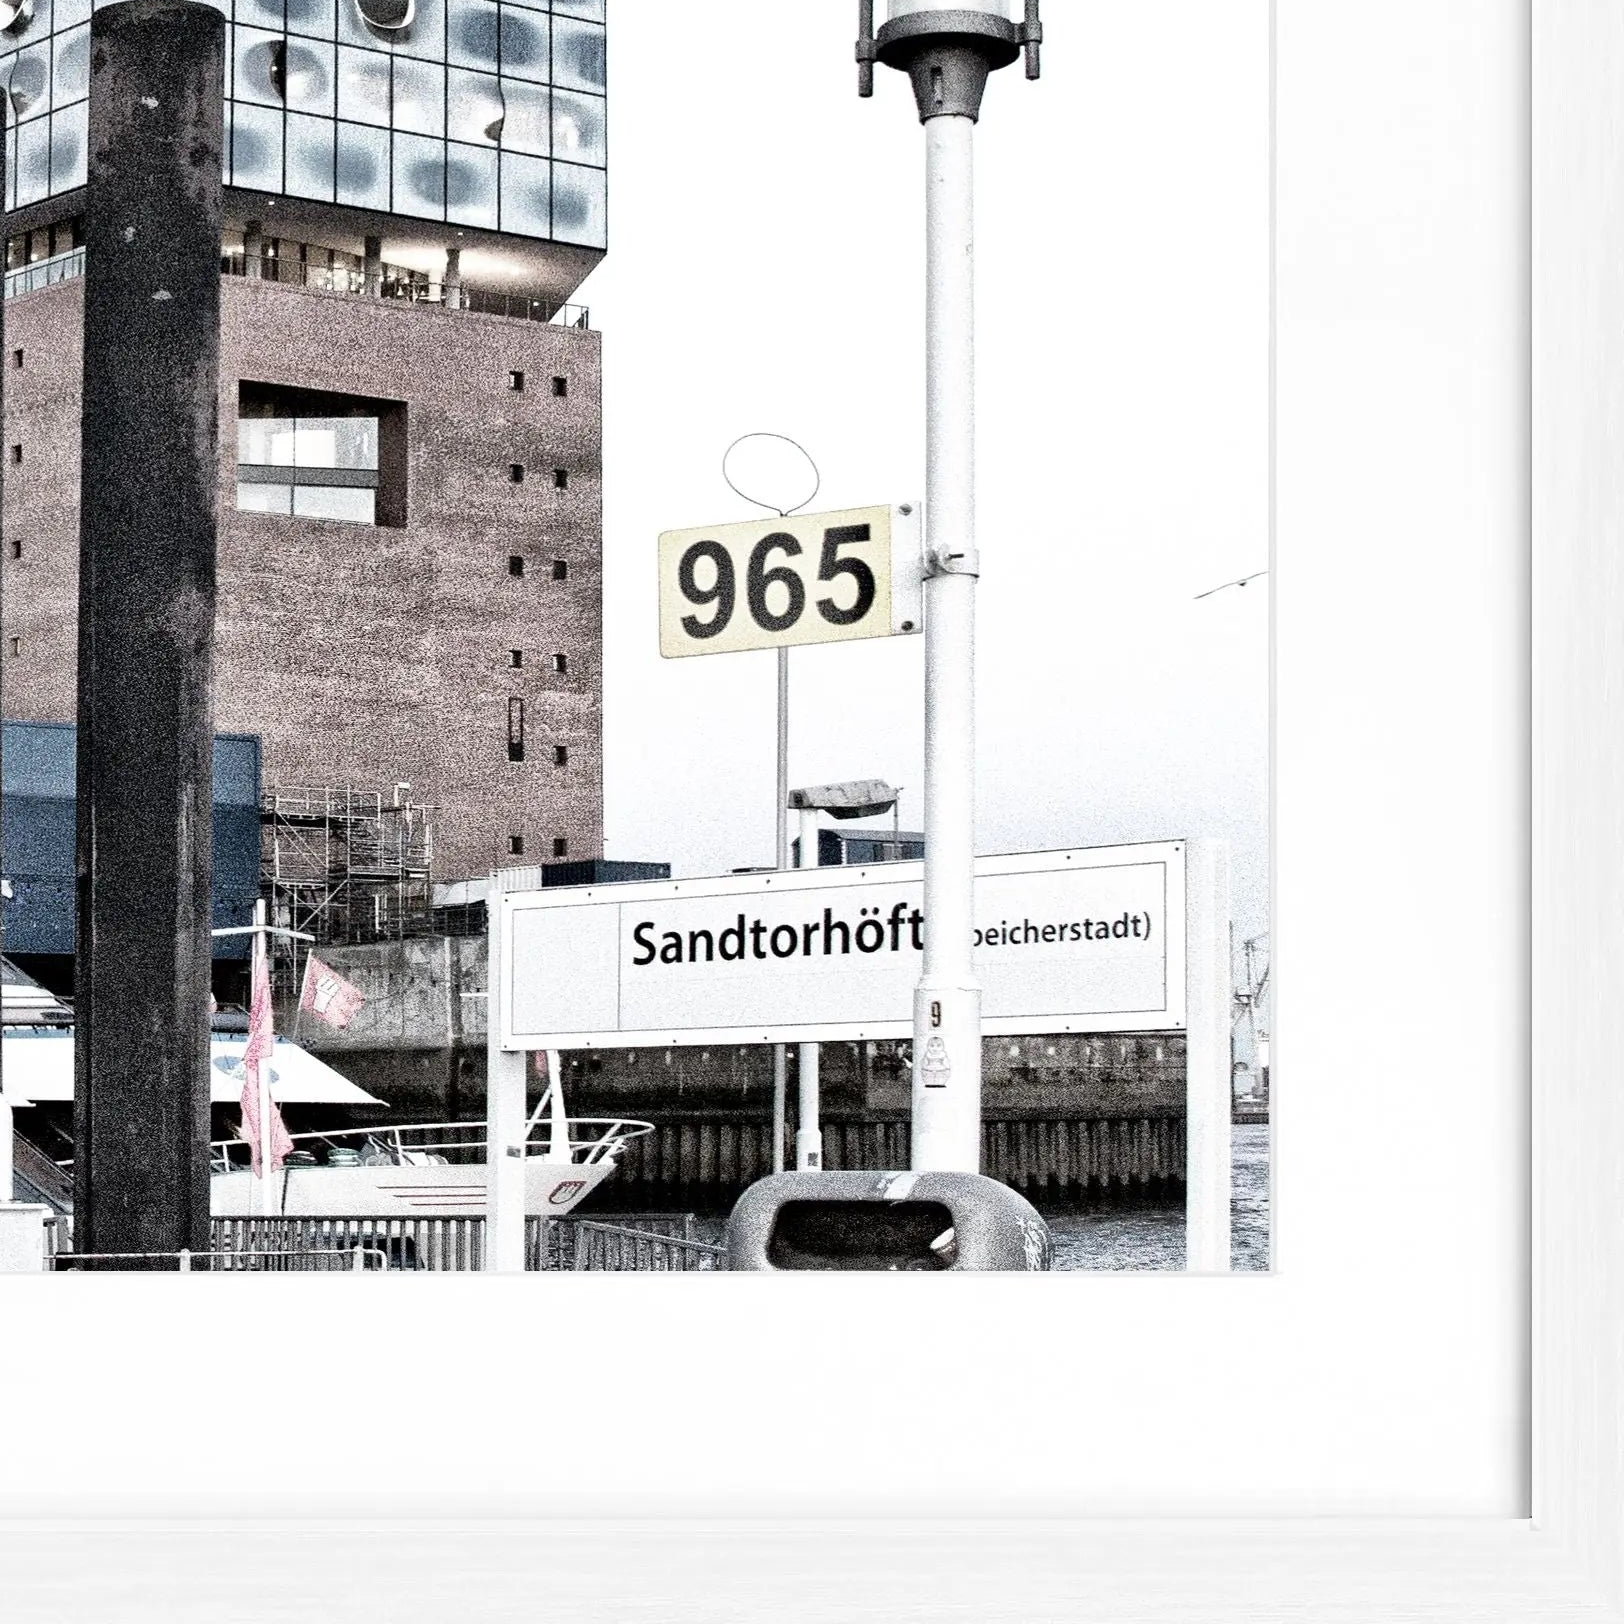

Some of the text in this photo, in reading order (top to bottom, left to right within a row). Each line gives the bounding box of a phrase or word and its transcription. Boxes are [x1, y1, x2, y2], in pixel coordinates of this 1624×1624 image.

[678, 523, 876, 639] 965
[633, 902, 1151, 966] Sandtorhöft eicherstadt)
[931, 1001, 942, 1028] 9
